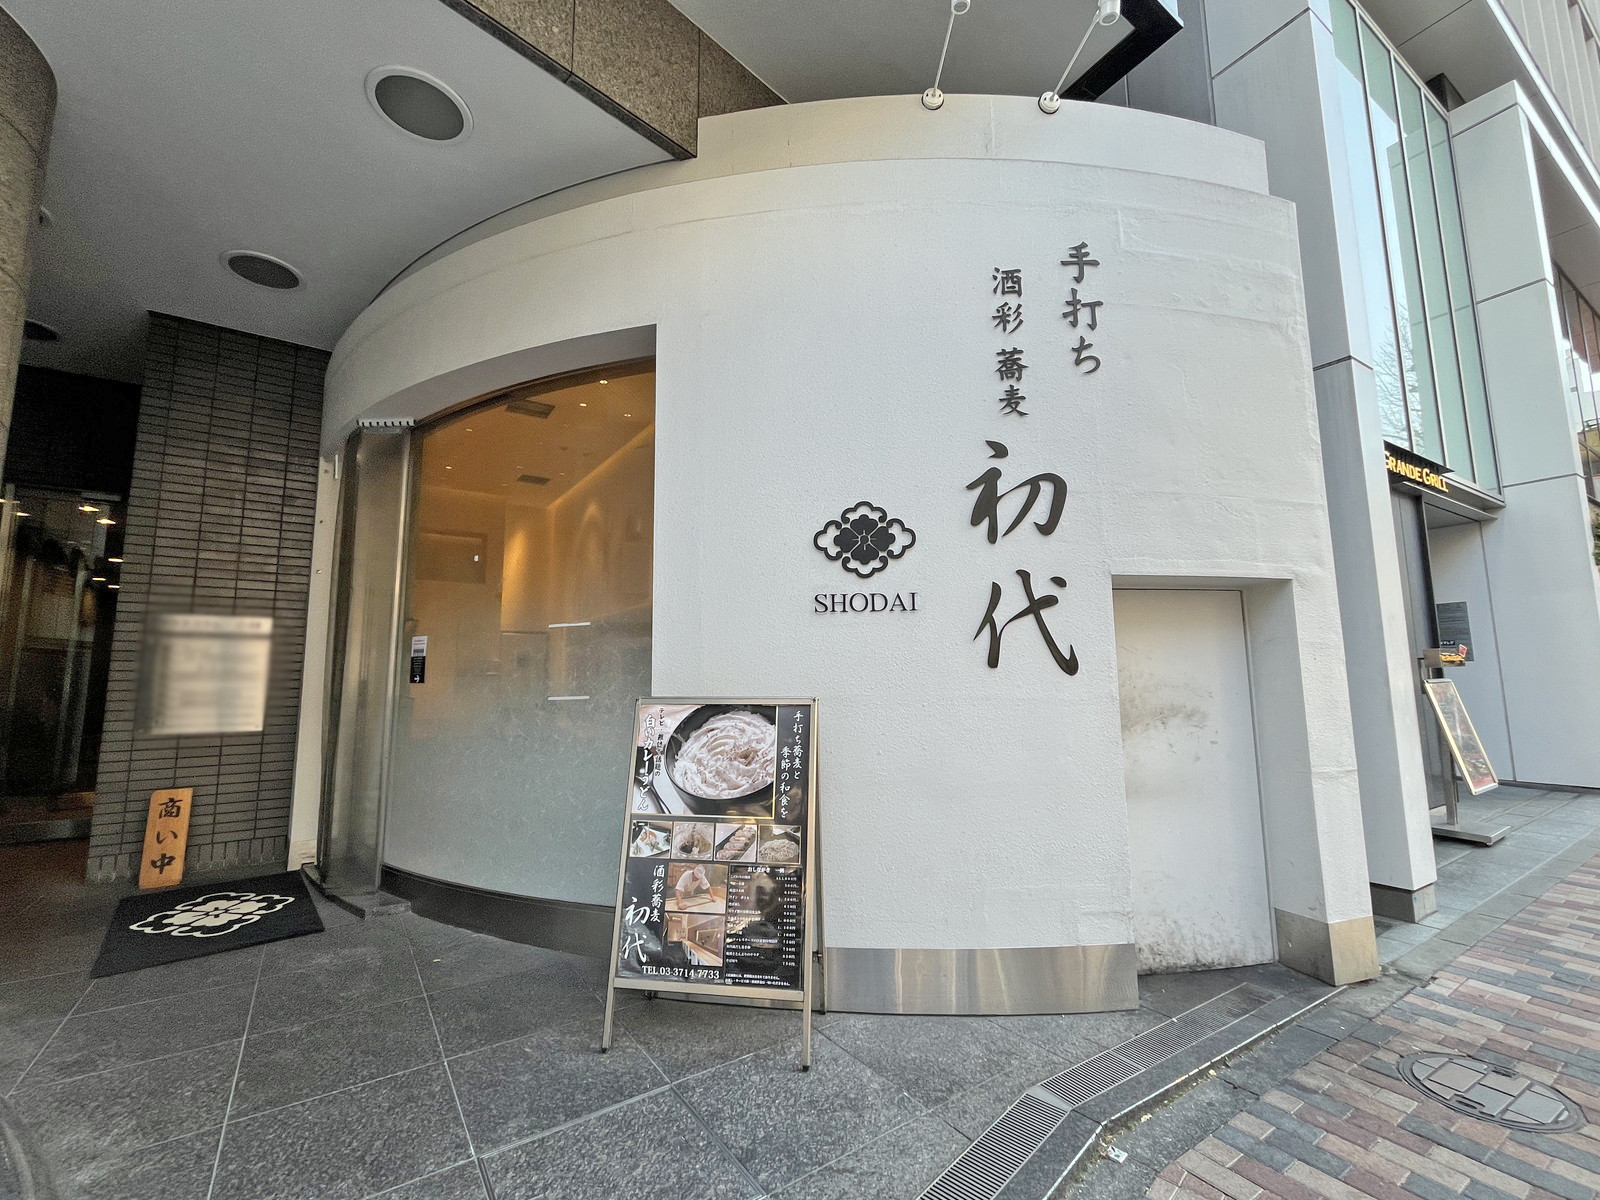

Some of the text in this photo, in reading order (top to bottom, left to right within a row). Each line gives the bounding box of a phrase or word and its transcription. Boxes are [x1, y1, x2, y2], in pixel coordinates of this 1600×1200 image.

[1060, 241, 1104, 374] 手打ち
[1422, 468, 1449, 492] GRILL
[966, 440, 1079, 676] 初代
[813, 592, 919, 614] SHODAI
[792, 710, 804, 780] 手打ち蕎麦と
[779, 745, 792, 819] 季節の和食を
[150, 797, 184, 875] 商い中
[650, 864, 665, 923] 酒彩蕎麦
[622, 896, 650, 963] 初代
[642, 965, 658, 975] TEL
[659, 967, 720, 980] 03-3714-7733
